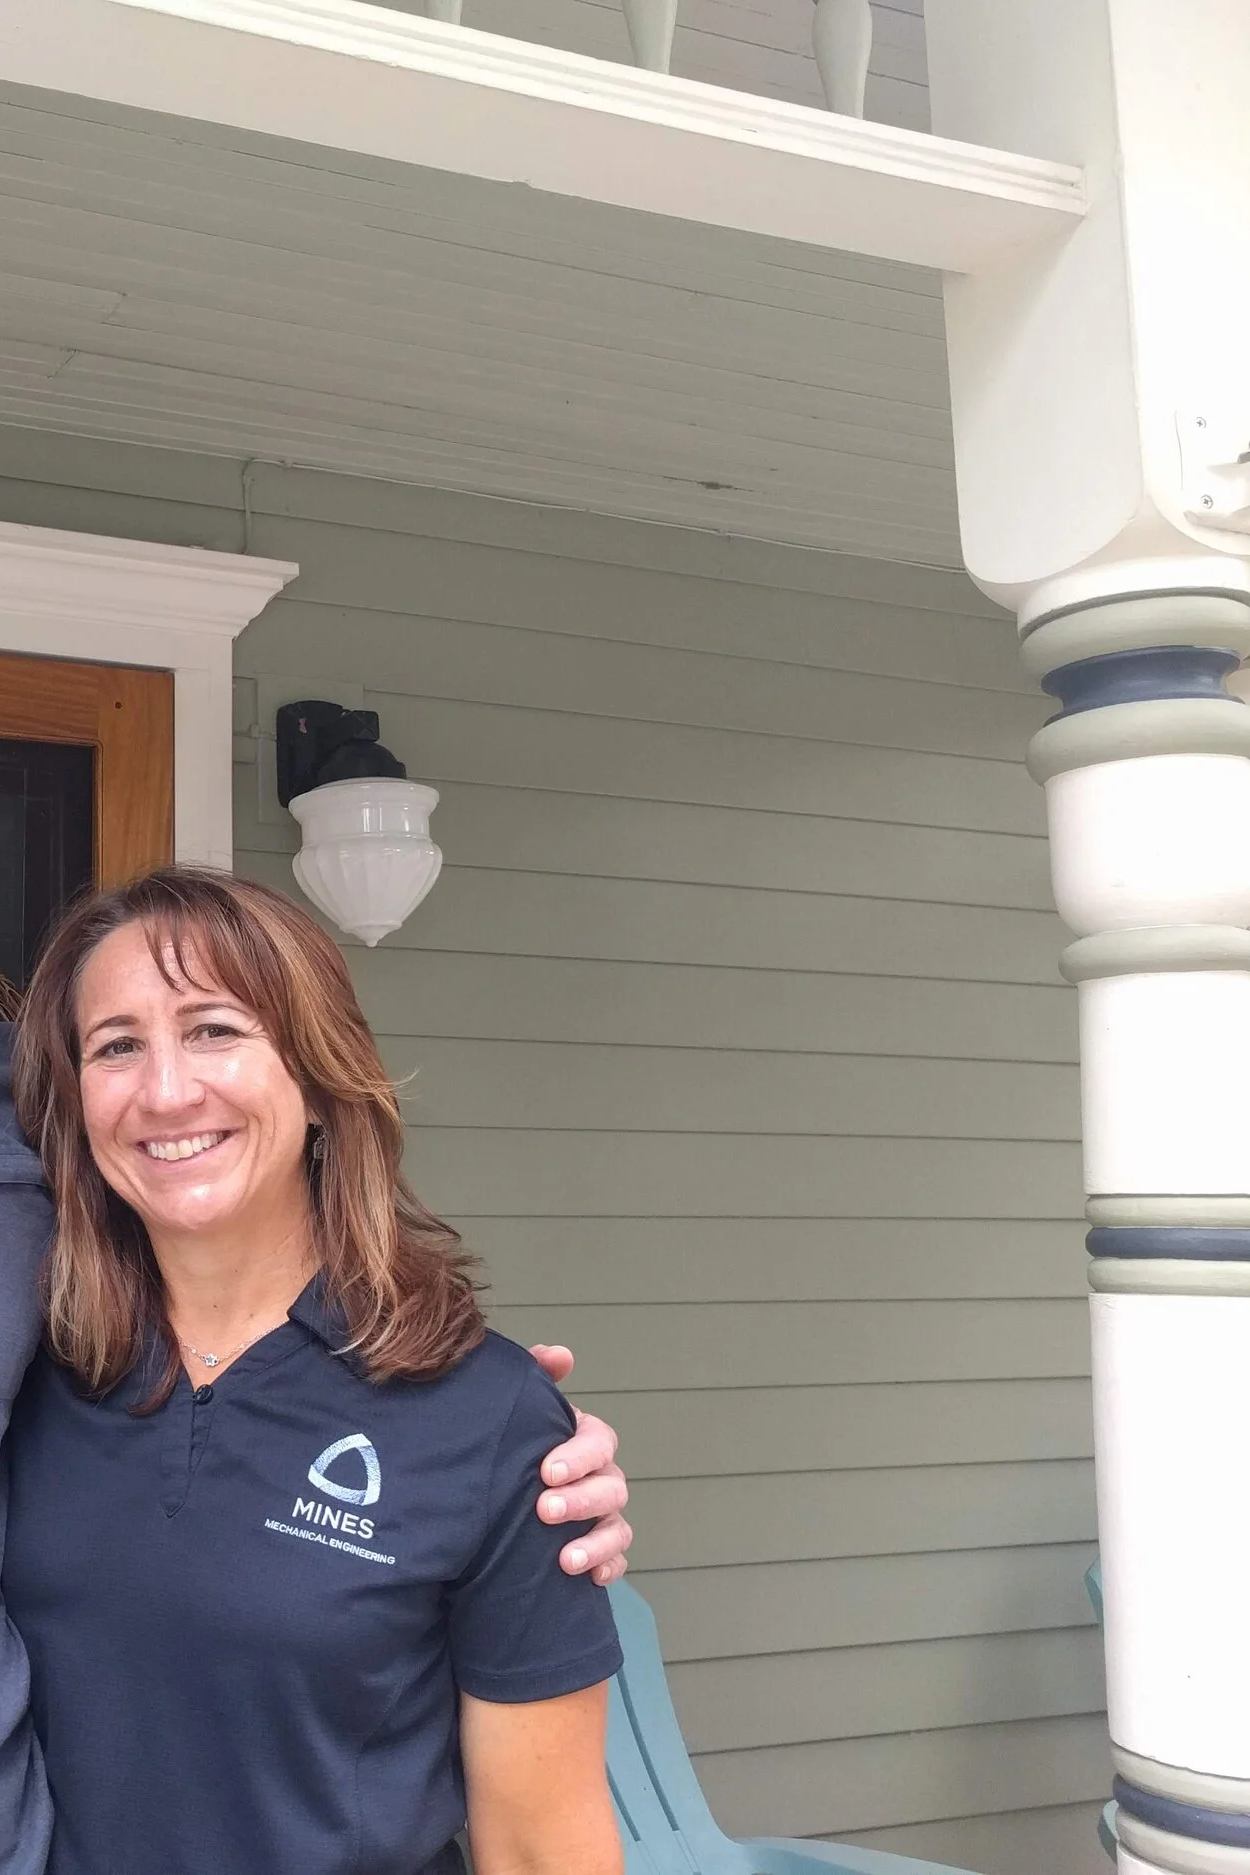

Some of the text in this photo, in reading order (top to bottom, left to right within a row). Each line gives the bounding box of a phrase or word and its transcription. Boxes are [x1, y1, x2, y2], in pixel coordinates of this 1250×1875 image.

[292, 1497, 375, 1539] MINES
[264, 1518, 396, 1565] MECHANICAL ENGINEERING
